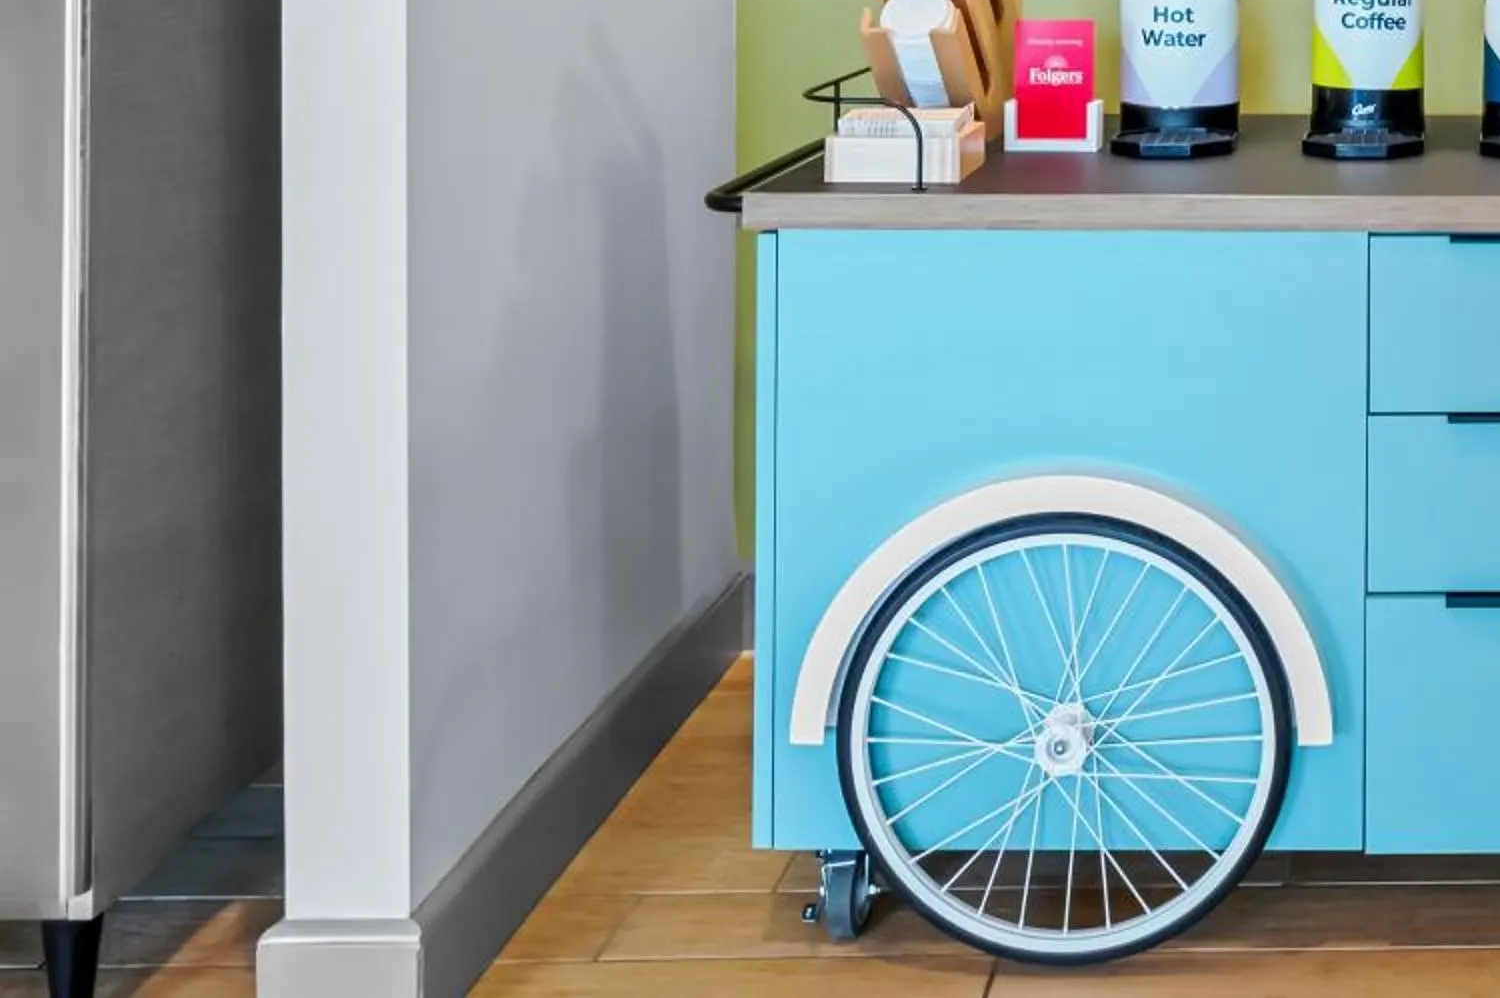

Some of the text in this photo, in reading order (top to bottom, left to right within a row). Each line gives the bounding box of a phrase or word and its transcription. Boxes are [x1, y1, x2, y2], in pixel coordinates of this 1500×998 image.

[1153, 5, 1195, 24] Hot
[1341, 12, 1407, 31] Coffee
[1141, 27, 1207, 48] Water
[1029, 67, 1083, 86] Folgers
